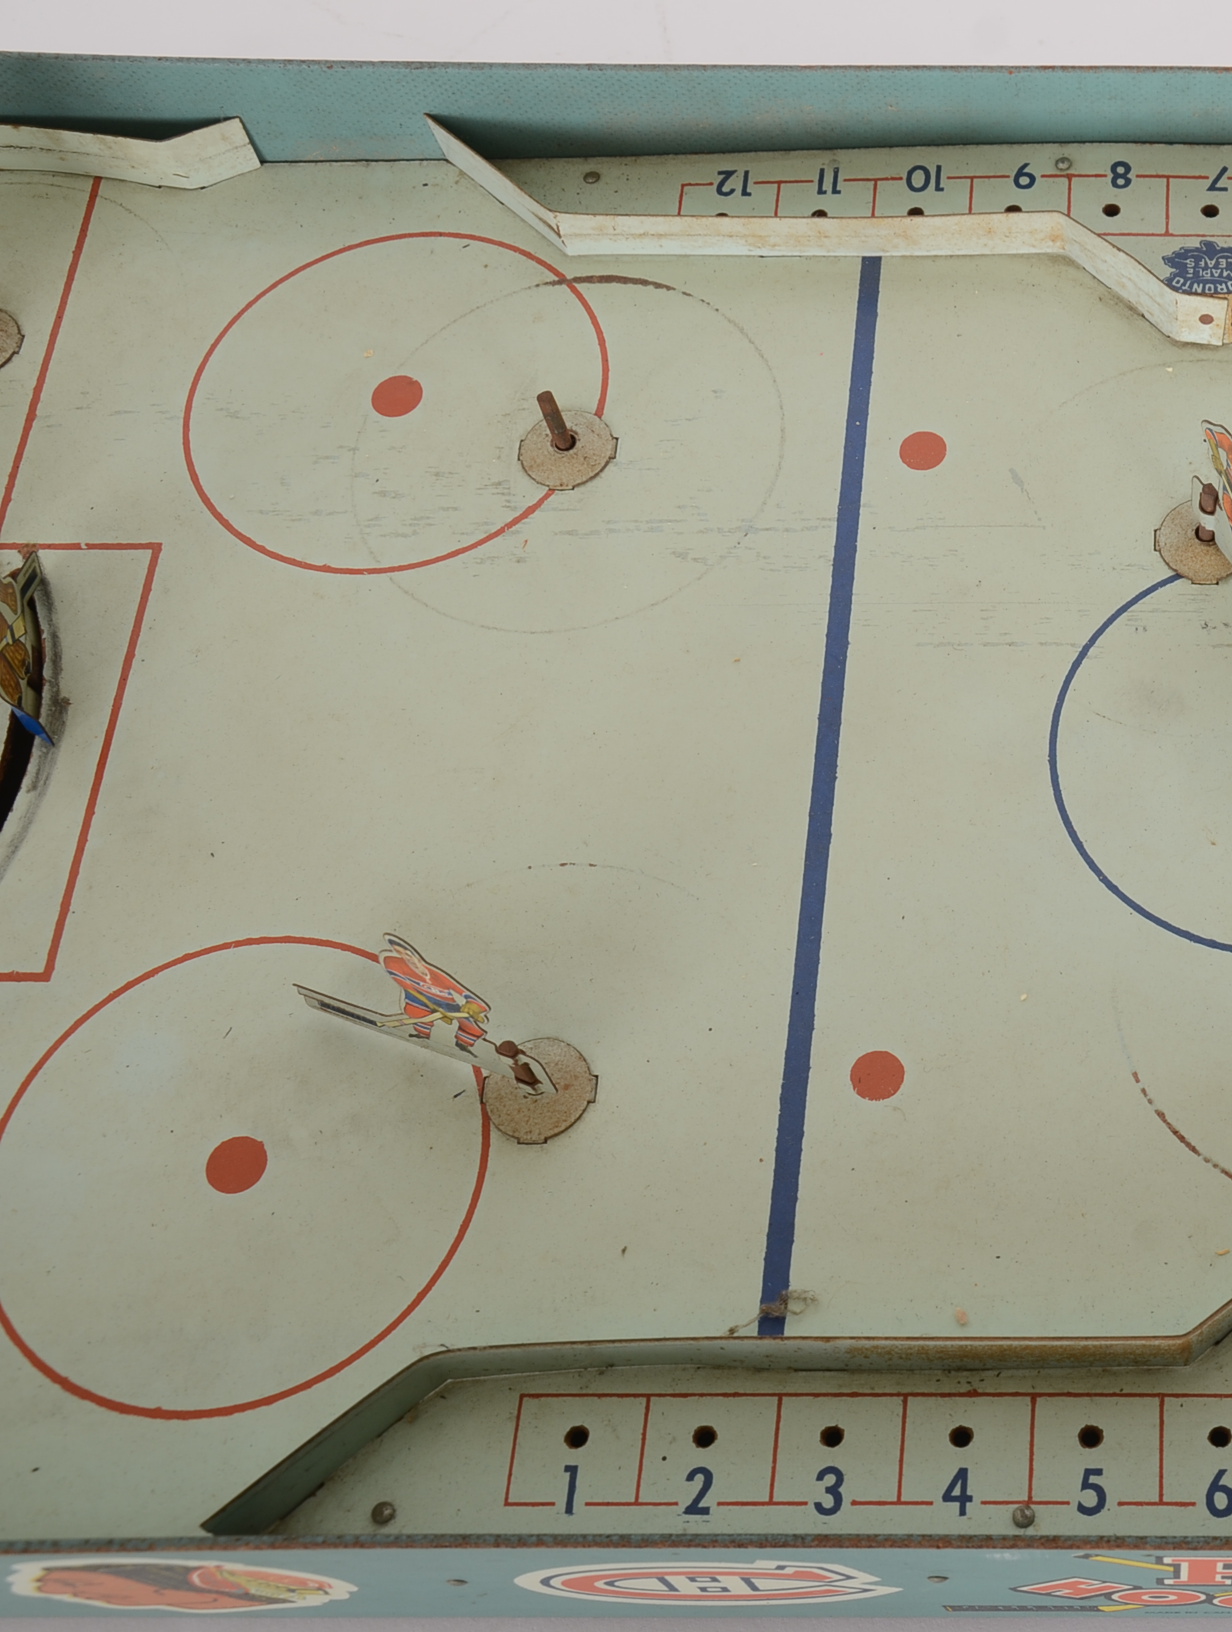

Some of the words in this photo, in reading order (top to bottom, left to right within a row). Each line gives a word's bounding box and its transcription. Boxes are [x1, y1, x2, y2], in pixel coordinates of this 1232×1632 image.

[715, 169, 752, 197] 12
[816, 167, 842, 196] 11
[905, 164, 945, 193] 10
[1012, 162, 1037, 190] 9
[1109, 161, 1133, 190] 8
[1206, 166, 1229, 192] 7
[563, 1465, 579, 1515] 1
[683, 1466, 714, 1516] 2
[814, 1466, 845, 1516] 3
[941, 1467, 974, 1517] 4
[1077, 1468, 1107, 1517] 5
